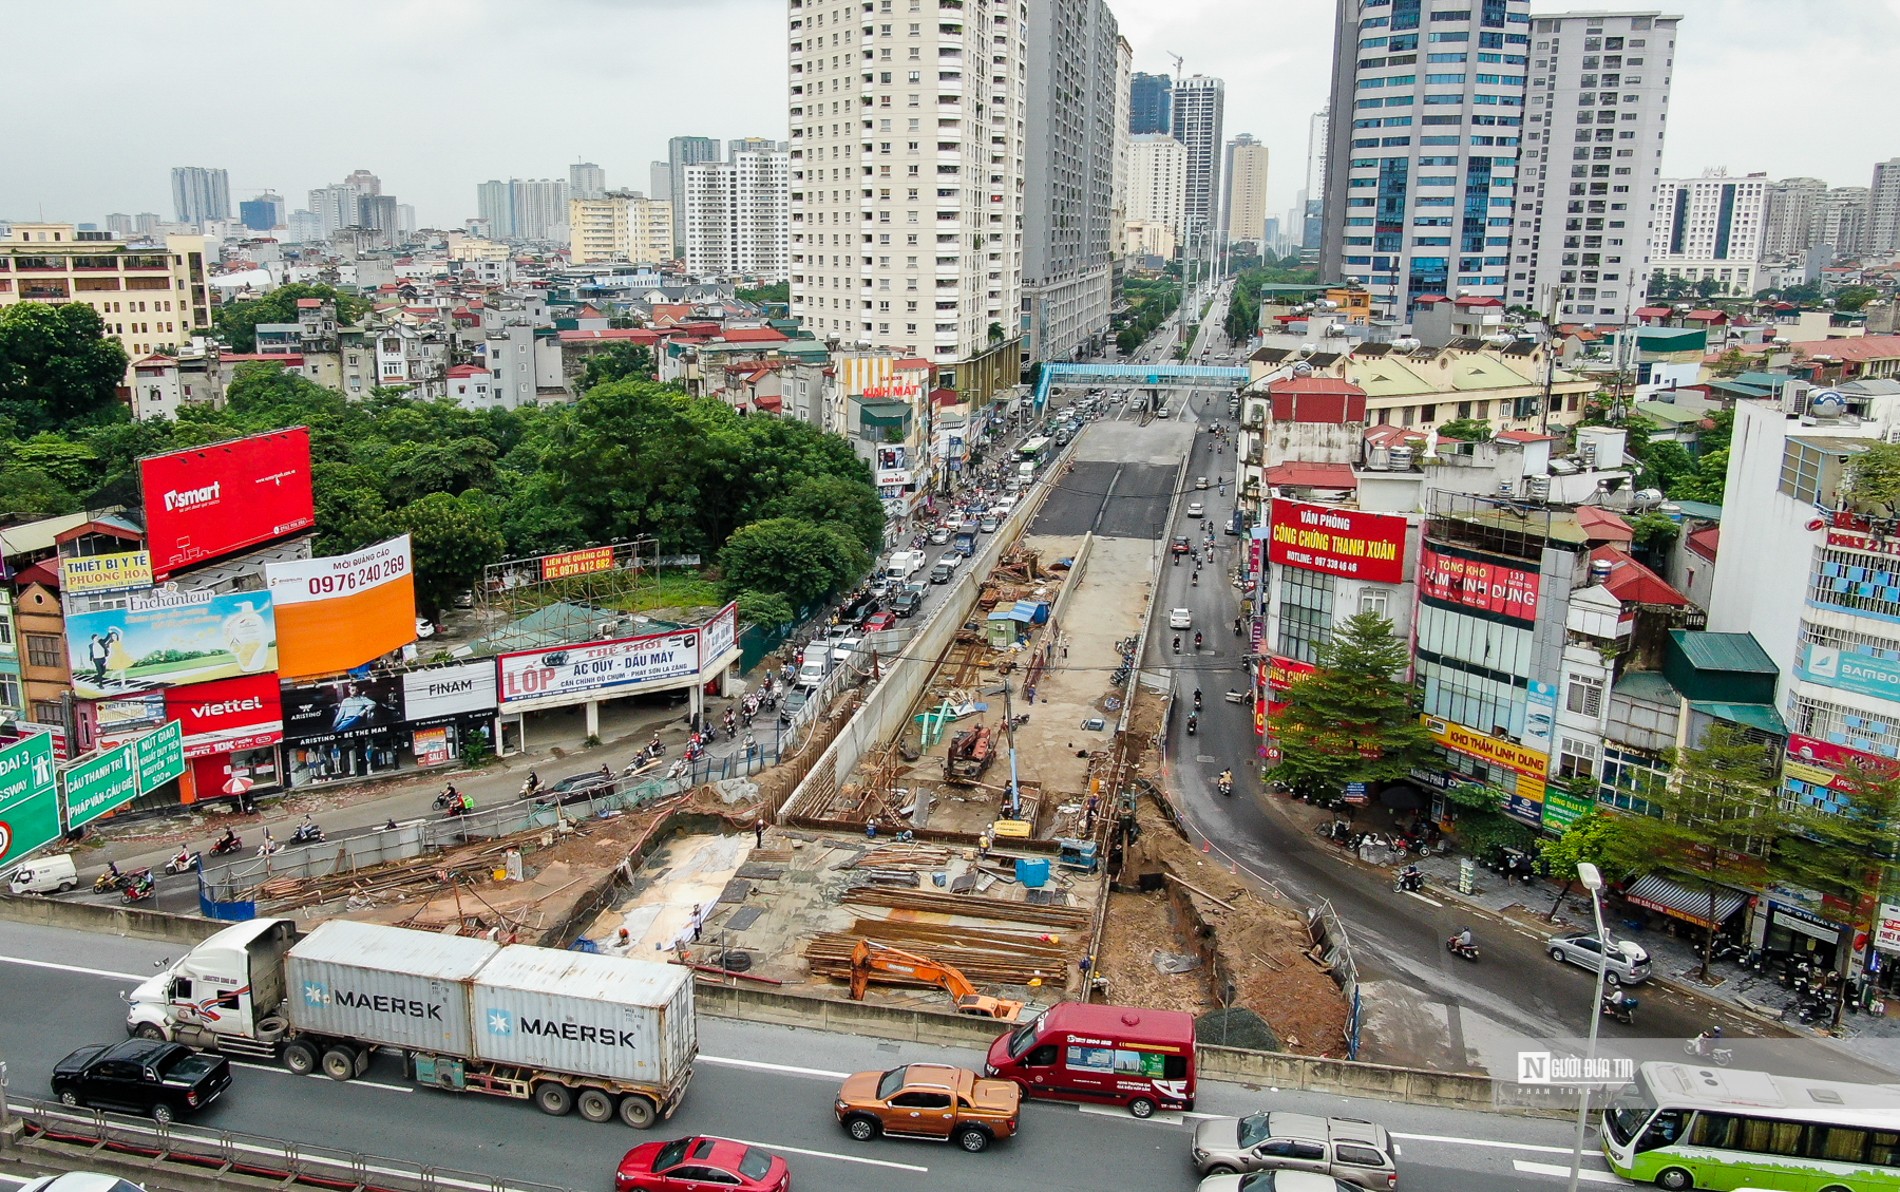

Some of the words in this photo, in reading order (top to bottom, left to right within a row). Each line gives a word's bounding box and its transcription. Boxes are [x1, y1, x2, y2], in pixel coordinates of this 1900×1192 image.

[1300, 510, 1318, 525] VĂN
[1319, 514, 1351, 531] PHÒNG
[1273, 522, 1297, 545] CÔNG
[1298, 528, 1330, 551] CHỨNG
[1332, 535, 1366, 557] THANH
[1366, 538, 1397, 560] XUÂN
[67, 557, 101, 574] THIẾT
[121, 557, 129, 568] Y
[352, 553, 376, 567] QUẢNG
[376, 548, 390, 559] CÁO
[124, 568, 150, 580] HOA
[308, 573, 357, 595] 0976
[358, 563, 381, 587] 240
[383, 554, 404, 577] 269
[1439, 559, 1464, 573] TỔNG
[1465, 565, 1487, 578] KHO
[129, 589, 216, 611] Enchanteur
[592, 659, 614, 673] QUY
[650, 650, 675, 666] MÁY
[507, 660, 556, 695] LỐP
[1841, 664, 1900, 684] BAMBO
[429, 679, 473, 696] FINAM
[191, 696, 263, 718] viettel
[290, 711, 322, 721] ARISTINO
[157, 727, 176, 743] GIAO
[300, 734, 336, 746] ARISTINO
[343, 730, 354, 739] BE
[355, 728, 370, 737] THE
[370, 726, 388, 735] MAN
[21, 750, 31, 766] 3
[427, 751, 444, 761] SALE
[1450, 731, 1469, 745] KHO
[1470, 738, 1494, 754] THẢM
[1495, 746, 1516, 762] LINH
[1517, 753, 1545, 771] DUNG
[84, 764, 111, 785] THANH
[334, 989, 443, 1022] MAERSK
[520, 1016, 637, 1050] MAERSK
